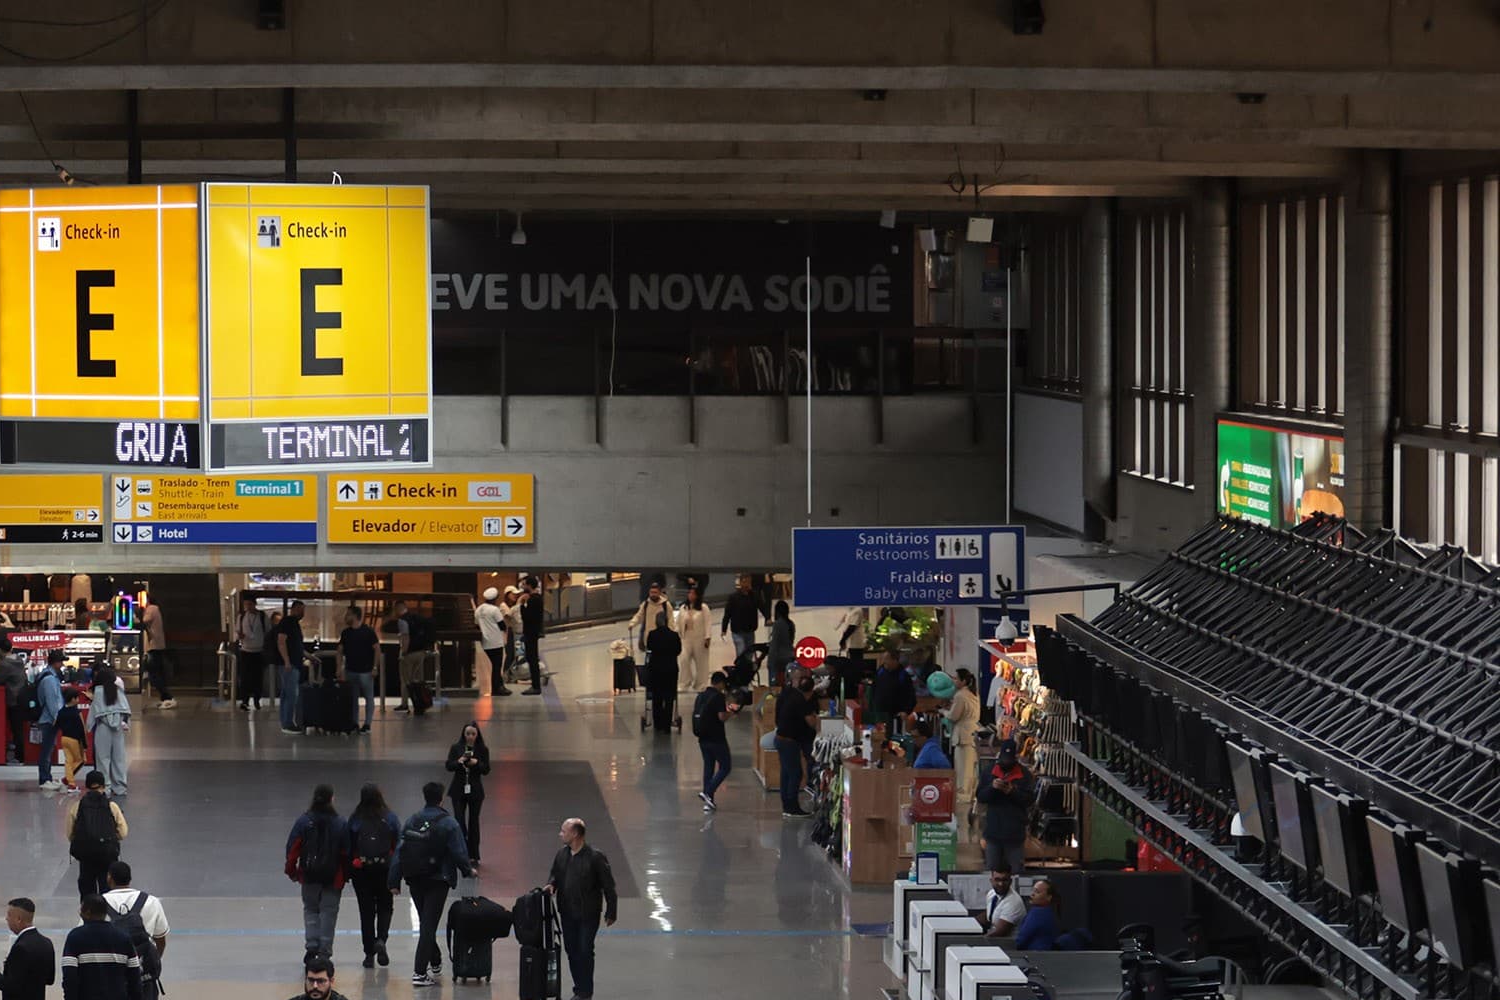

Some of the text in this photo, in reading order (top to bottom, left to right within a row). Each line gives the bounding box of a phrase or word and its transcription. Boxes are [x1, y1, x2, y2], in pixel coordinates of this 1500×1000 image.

[65, 223, 120, 240] Check-in
[287, 221, 347, 239] Check-in
[431, 264, 891, 313] EVE UMA NOVA SODIÊ
[75, 269, 116, 378] E
[299, 268, 344, 376] E
[115, 422, 165, 463] GRU
[262, 423, 410, 460] TERMINAL 2
[159, 479, 198, 488] Traslado
[206, 479, 230, 488] Trem
[238, 481, 301, 495] Terminal 1
[387, 483, 458, 498] Check-in
[159, 490, 195, 498] Shuttle
[202, 490, 225, 498] Train
[158, 502, 239, 511] Desembarque Leste
[158, 511, 208, 520] East arrivals
[158, 528, 188, 539] Hotel
[352, 520, 417, 533] Elevador
[429, 520, 478, 533] Elevator
[858, 532, 930, 546] Sanitários
[856, 549, 930, 561] Restrooms
[890, 571, 953, 583] Fraldário
[864, 587, 953, 602] Baby change
